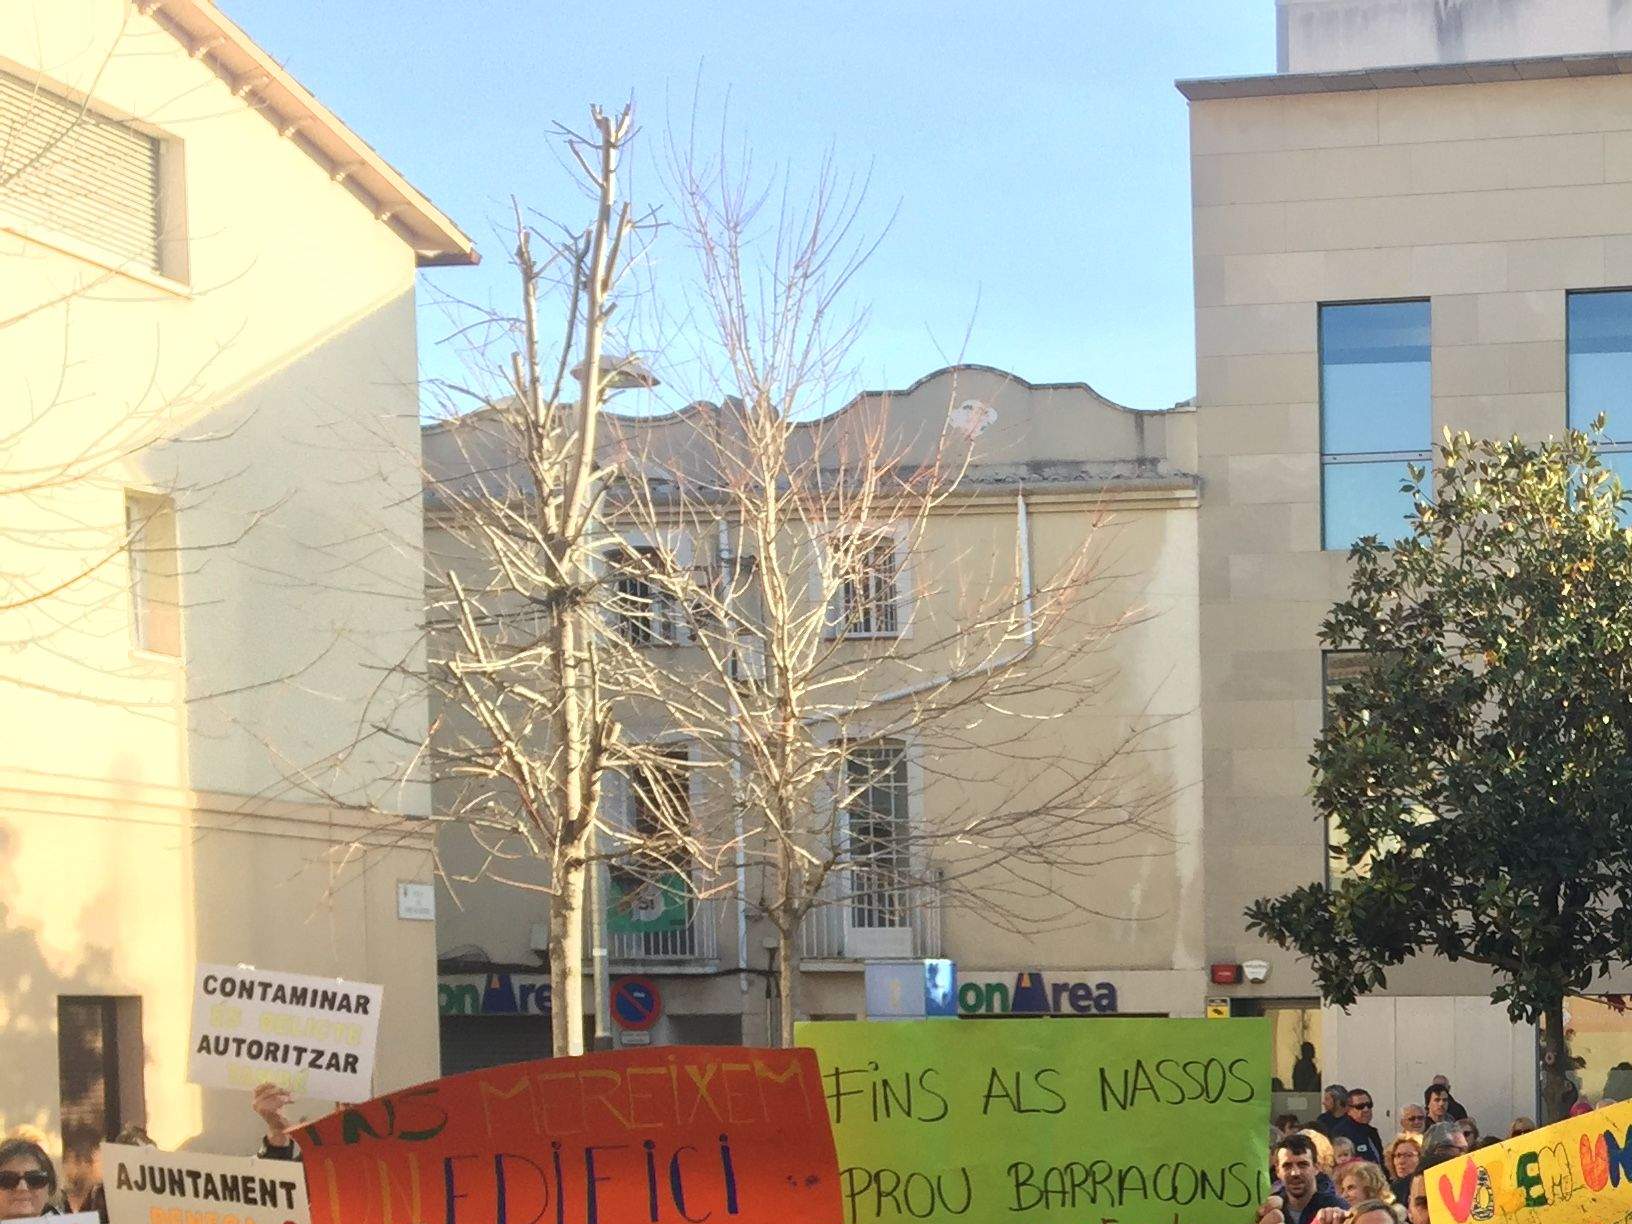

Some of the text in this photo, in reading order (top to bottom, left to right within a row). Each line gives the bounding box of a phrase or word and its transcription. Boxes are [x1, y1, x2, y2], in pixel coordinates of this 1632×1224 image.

[202, 974, 371, 1016] CONTAMINAR
[196, 1034, 360, 1075] AUTORITZAR
[983, 1066, 1068, 1116] ALS
[1099, 1057, 1255, 1113] NASSOS
[116, 1162, 297, 1210] AJUNTAMENT
[1437, 1141, 1574, 1224] VOLEM
